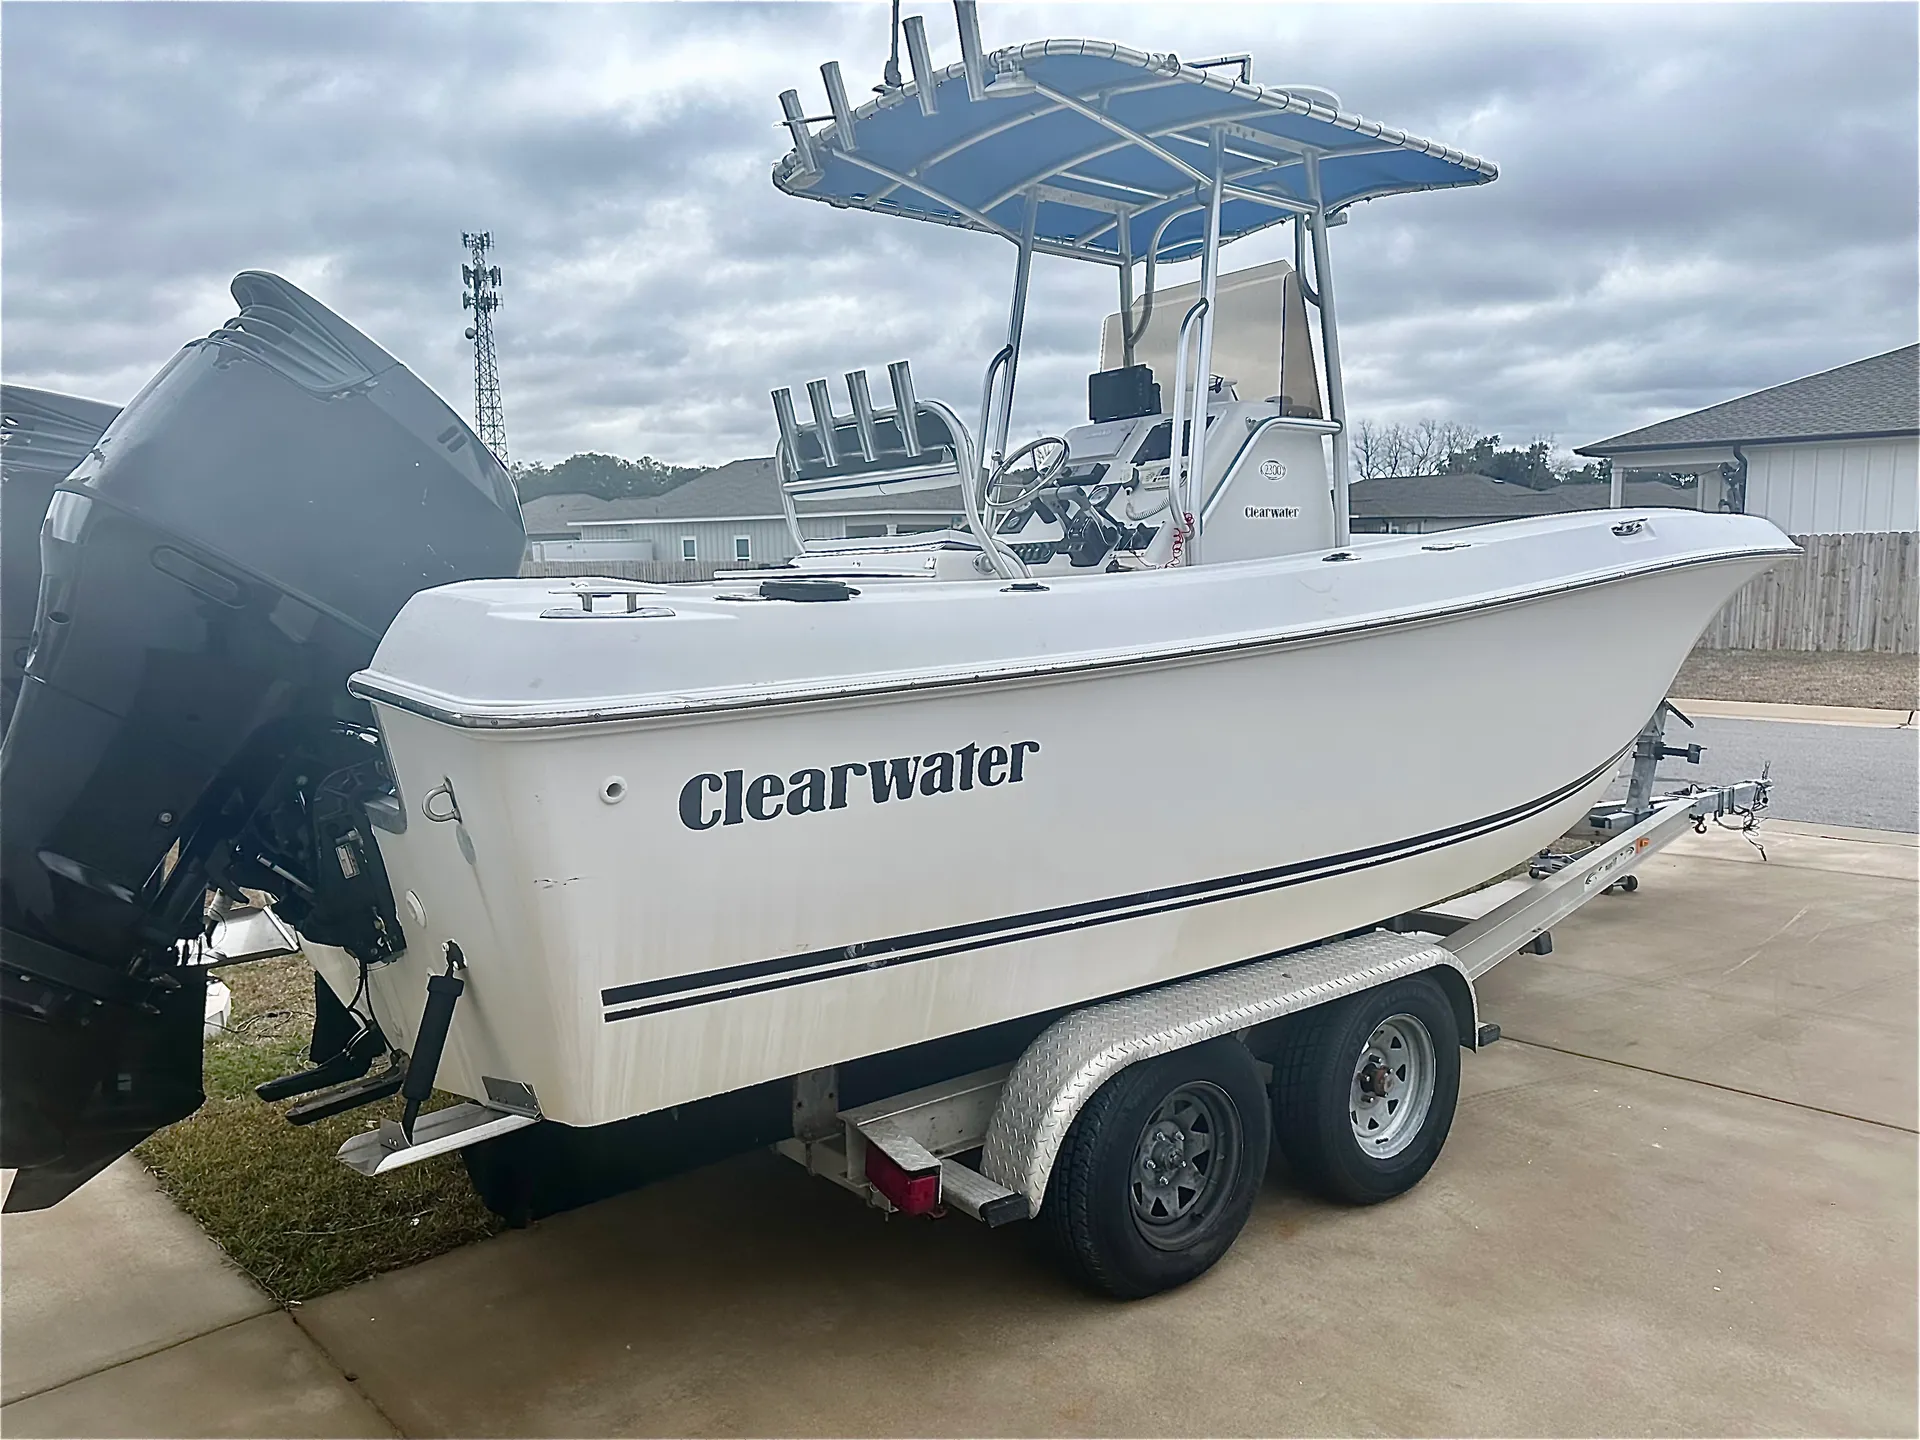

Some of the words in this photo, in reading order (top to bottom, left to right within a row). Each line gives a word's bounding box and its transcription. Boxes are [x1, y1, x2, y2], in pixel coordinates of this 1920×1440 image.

[1265, 464, 1282, 476] 2300
[1244, 506, 1300, 518] Clearwater
[679, 741, 1040, 830] Clearwater
